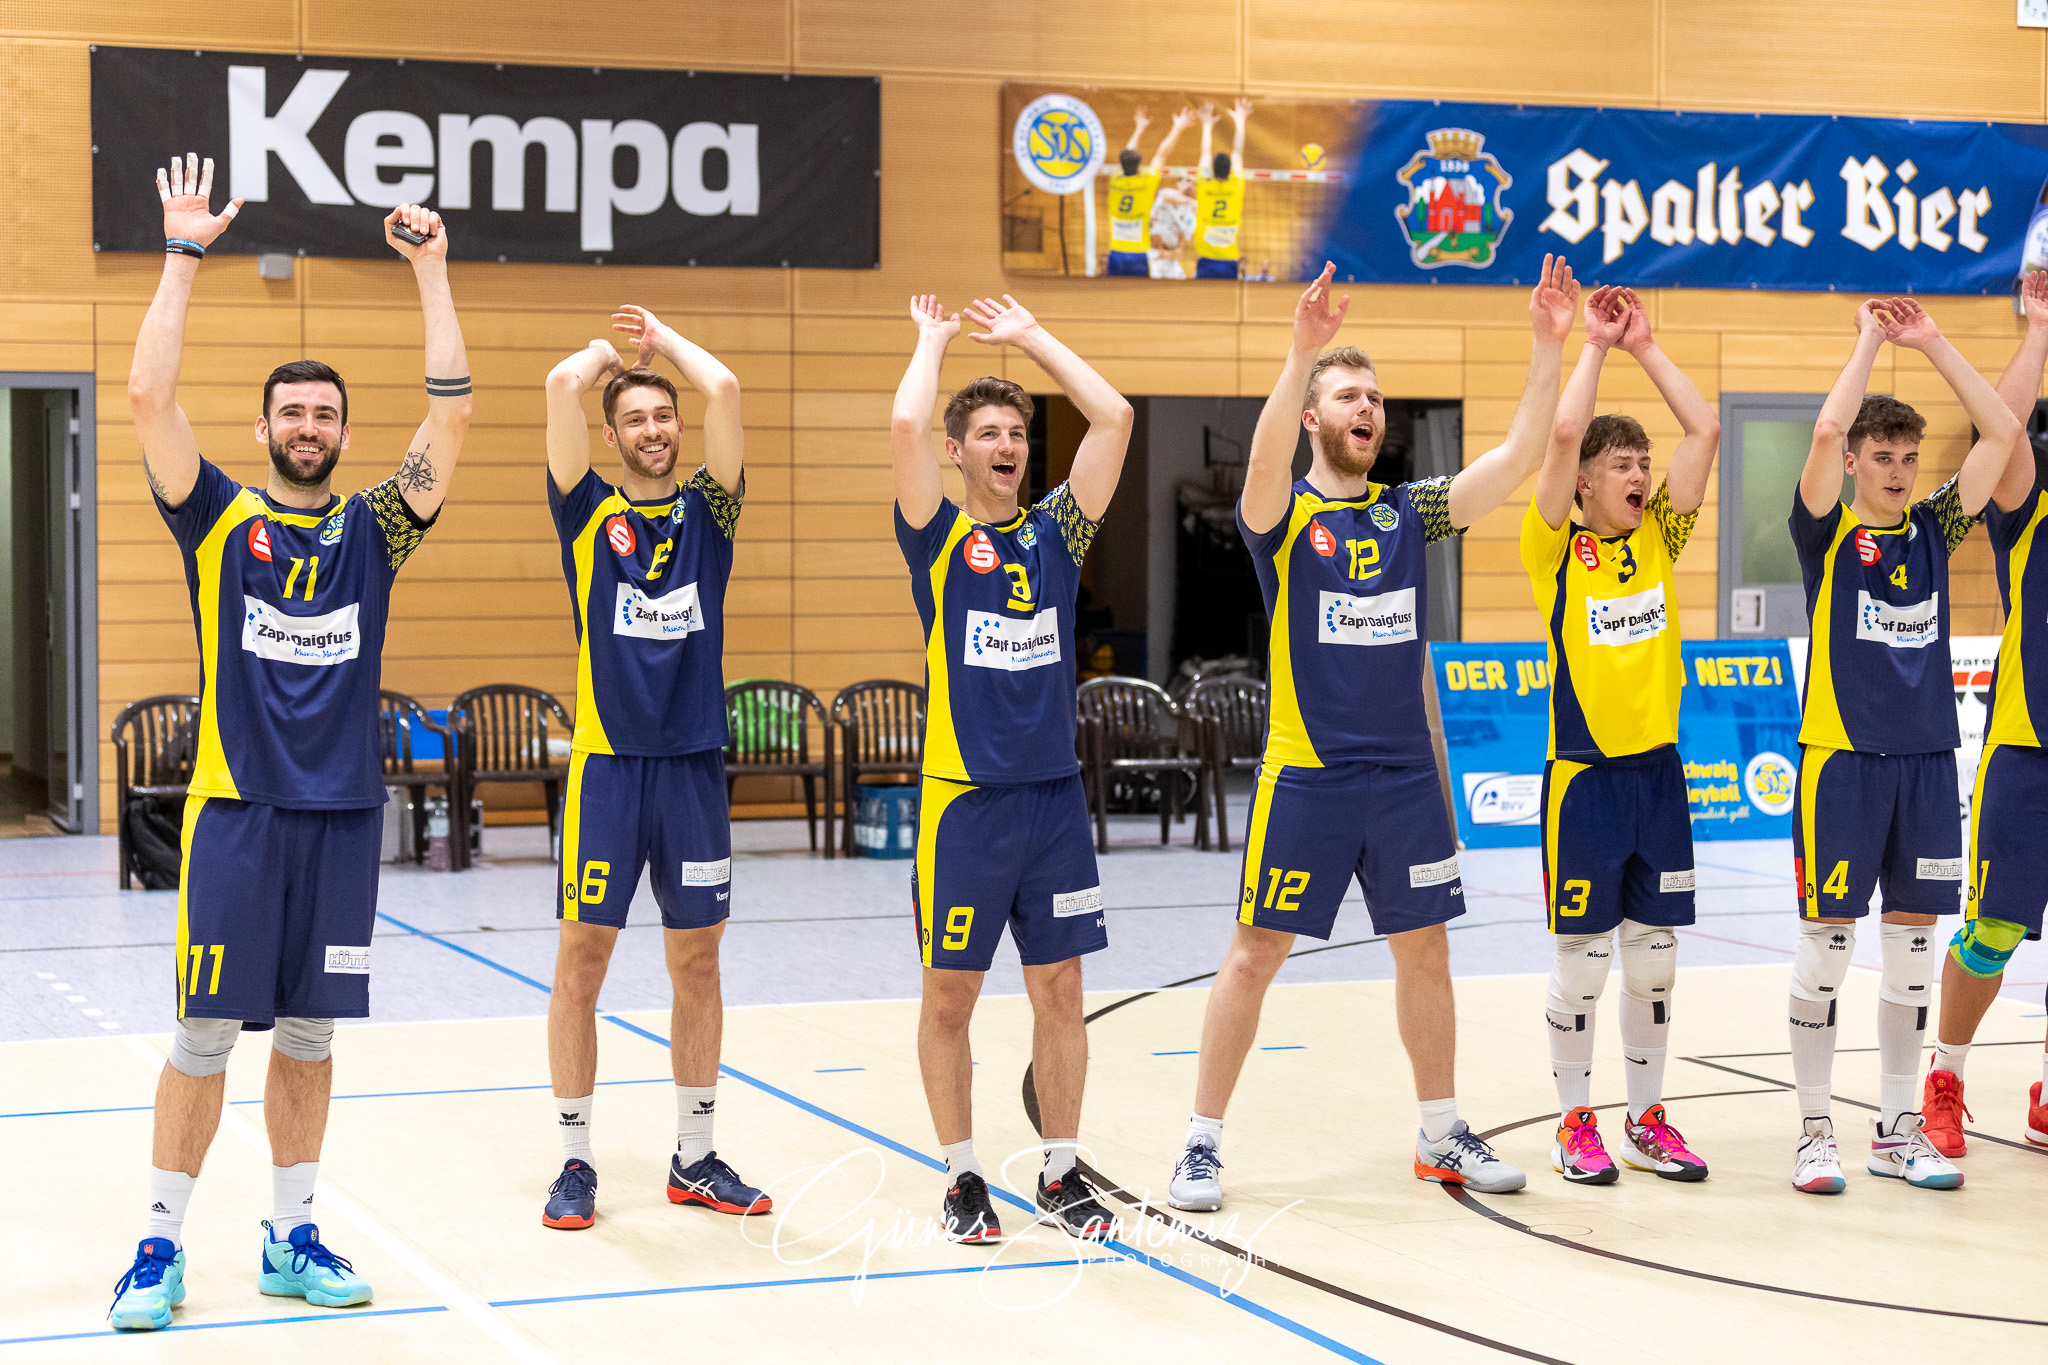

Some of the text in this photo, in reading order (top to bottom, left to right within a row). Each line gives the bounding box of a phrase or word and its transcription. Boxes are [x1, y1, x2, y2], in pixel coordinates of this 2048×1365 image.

[228, 65, 760, 251] Kempa
[1538, 147, 1992, 264] Spalter Bier
[1345, 538, 1382, 580] 12
[1610, 543, 1637, 584] 3
[1889, 564, 1908, 590] 4
[1368, 612, 1412, 628] Daigfuss
[1600, 616, 1626, 632] apf
[1446, 660, 1508, 691] DER
[1695, 656, 1783, 687] NETZ!
[1683, 760, 1738, 782] chwaig
[580, 860, 609, 904] 6
[1413, 861, 1459, 881] HÜTTING
[1663, 873, 1695, 887] HÜTTI
[1822, 860, 1849, 899] 4
[1920, 862, 1963, 875] HÜTTIN
[714, 891, 729, 902] Kemp
[1056, 892, 1103, 911] HÜTTIN
[1263, 867, 1309, 911] 12
[1559, 879, 1591, 917] 3
[942, 906, 975, 950] 9
[189, 945, 225, 995] 11
[329, 950, 370, 967] HÜTTI
